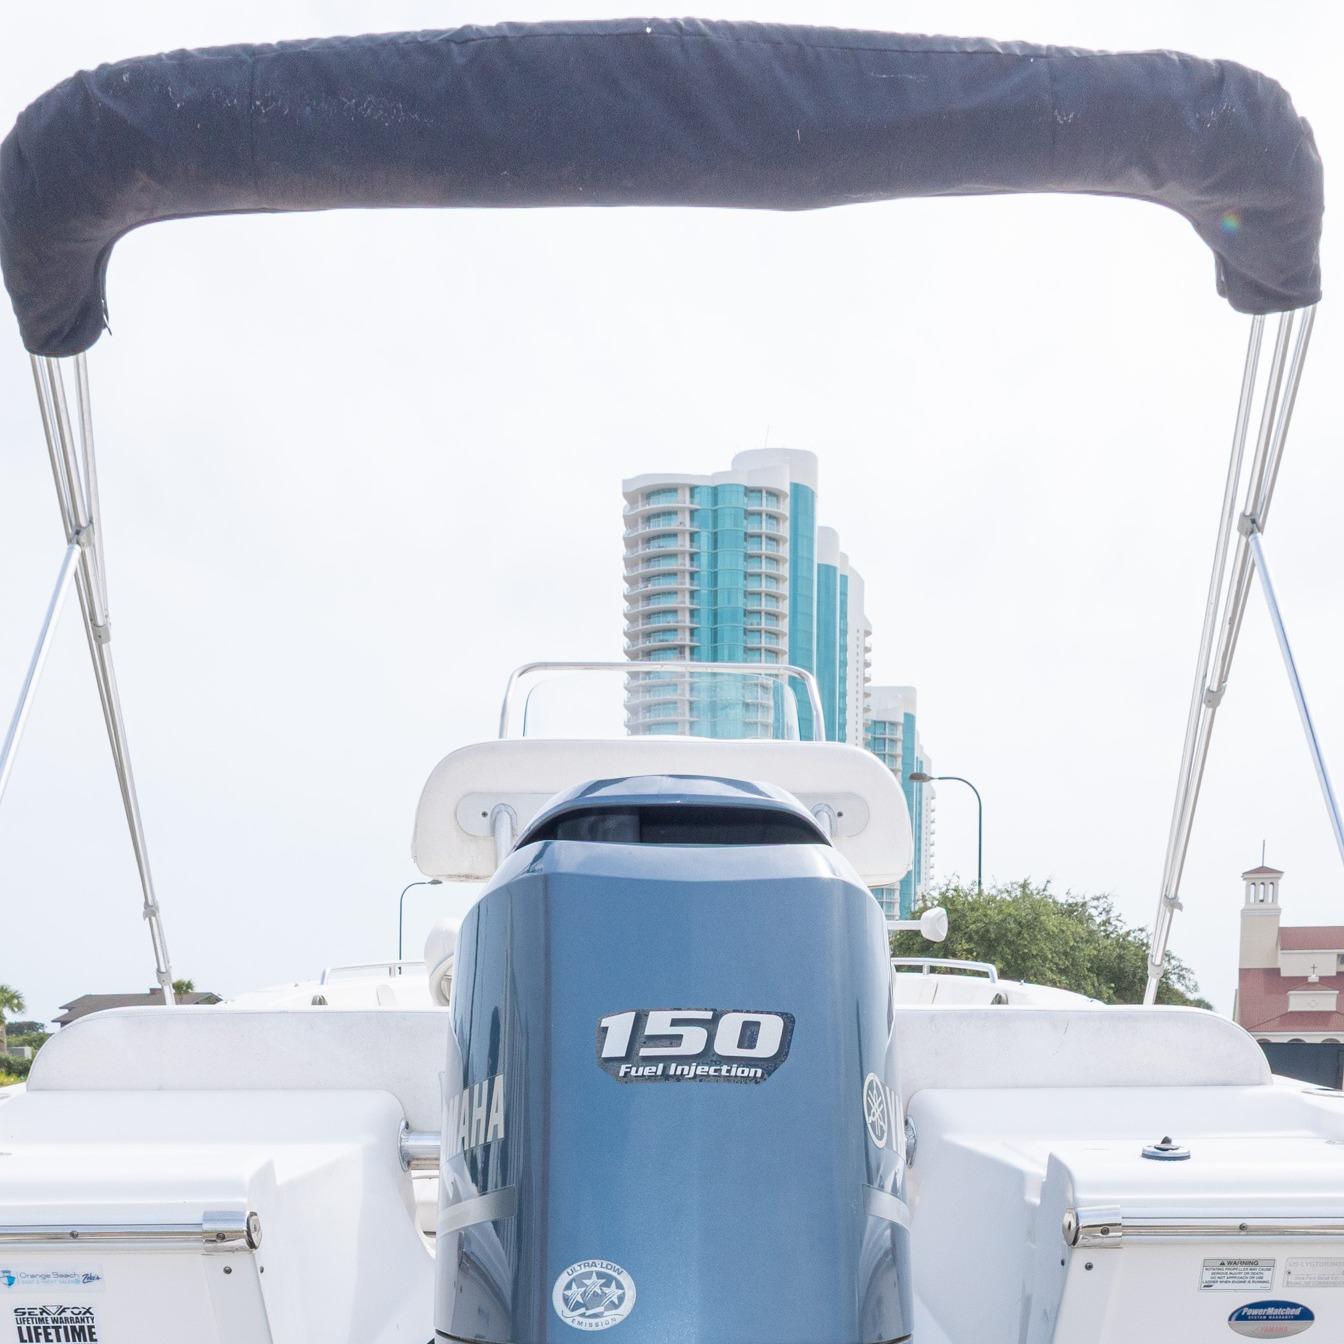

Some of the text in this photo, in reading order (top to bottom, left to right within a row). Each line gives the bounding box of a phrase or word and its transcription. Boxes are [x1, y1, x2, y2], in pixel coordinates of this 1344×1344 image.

[600, 1010, 785, 1059] 150
[619, 1062, 763, 1078] Fuel Injection
[19, 1272, 51, 1280] Orange
[1242, 1307, 1302, 1316] PowerMatched
[16, 1316, 95, 1325] LIFETIME WARRANTY
[571, 1317, 617, 1328] EMISSION
[17, 1325, 98, 1343] LIFETIME
